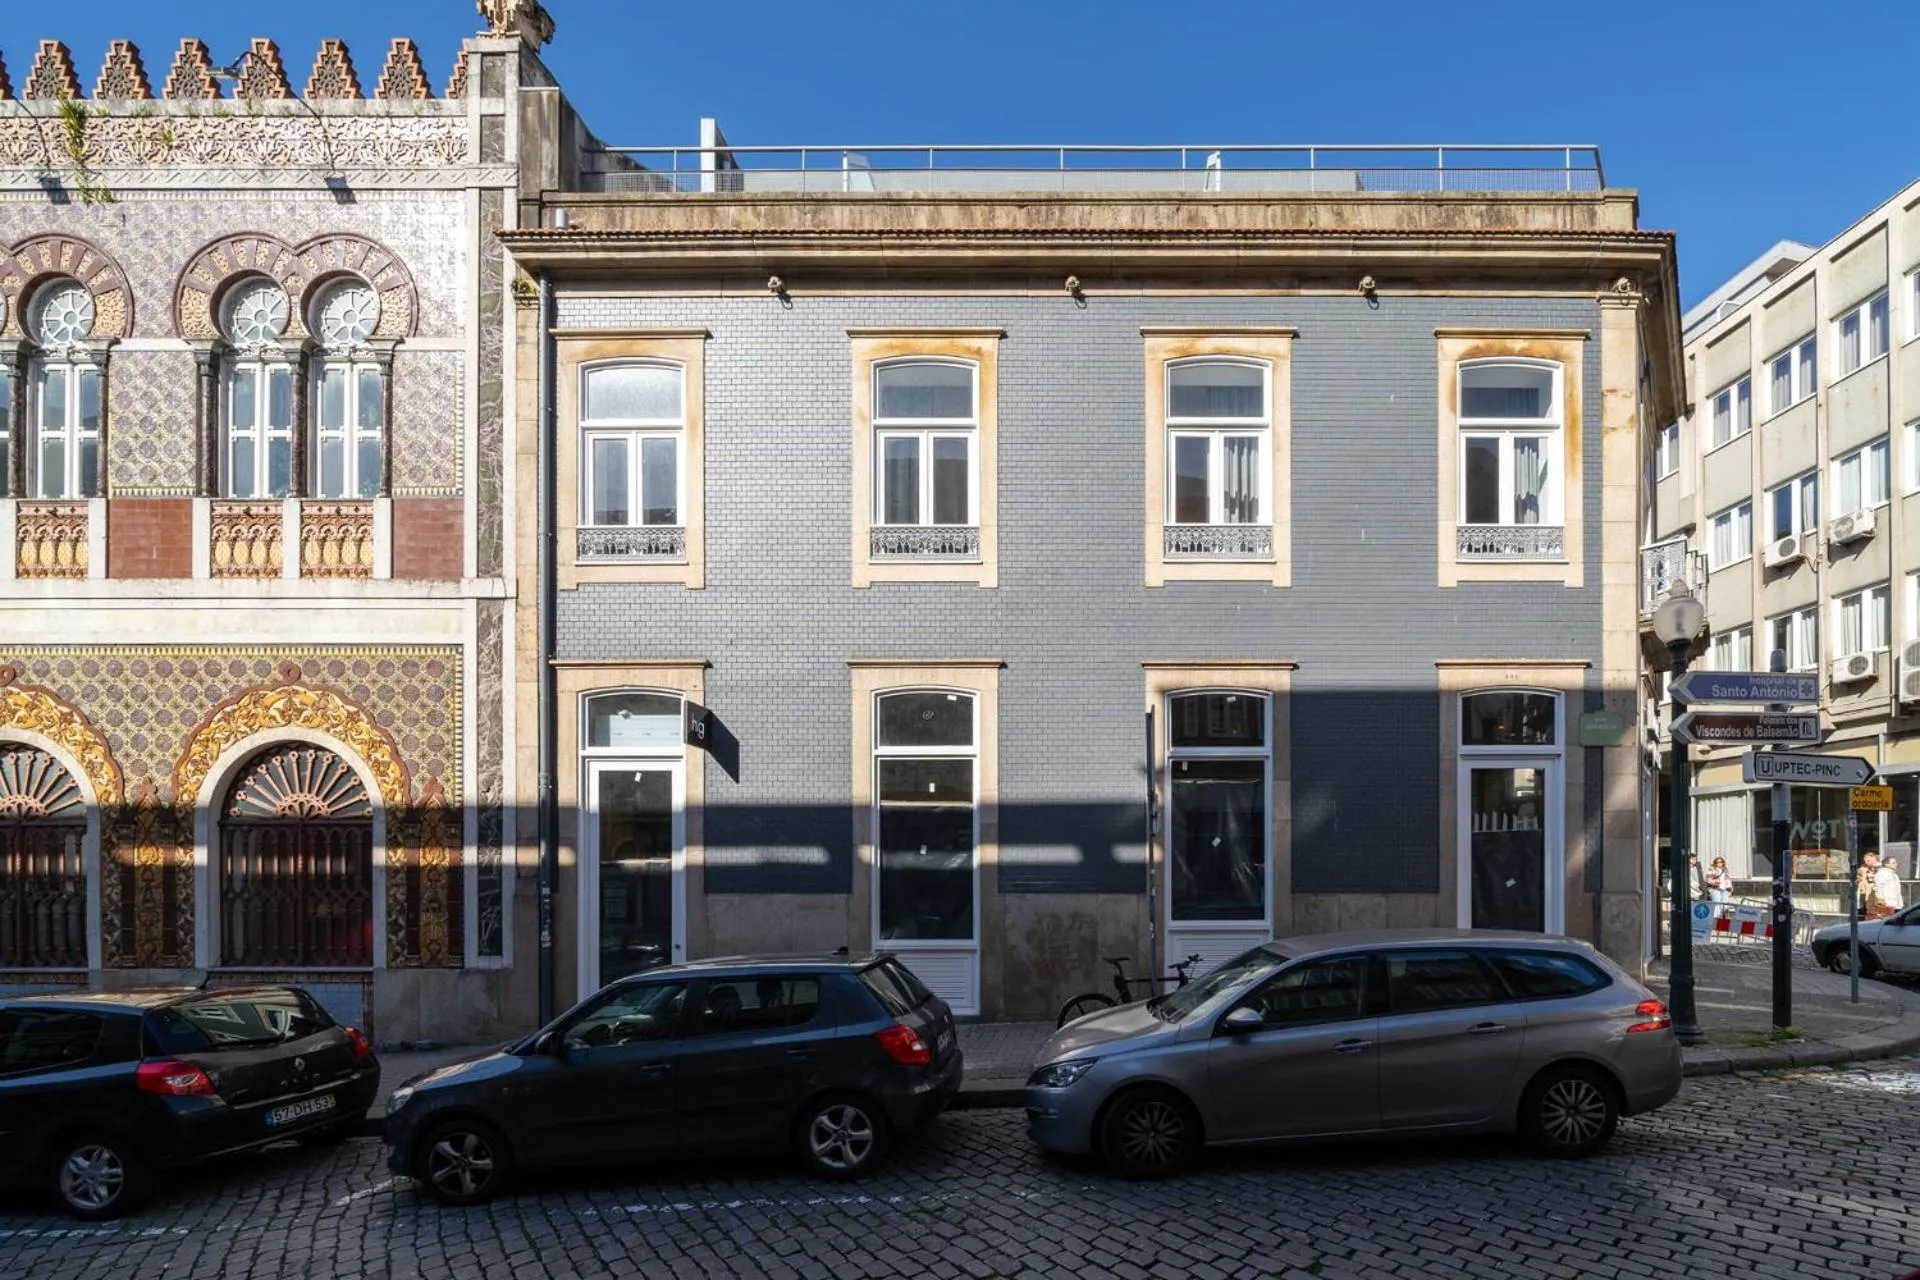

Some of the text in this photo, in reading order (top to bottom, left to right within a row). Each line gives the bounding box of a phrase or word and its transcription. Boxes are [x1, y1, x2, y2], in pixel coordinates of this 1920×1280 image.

[1711, 684, 1799, 698] Santo António
[1695, 724, 1741, 738] Viscondes
[1743, 725, 1754, 738] de
[1761, 760, 1841, 776] U UPTEC-PINC
[1853, 787, 1883, 798] Carmo
